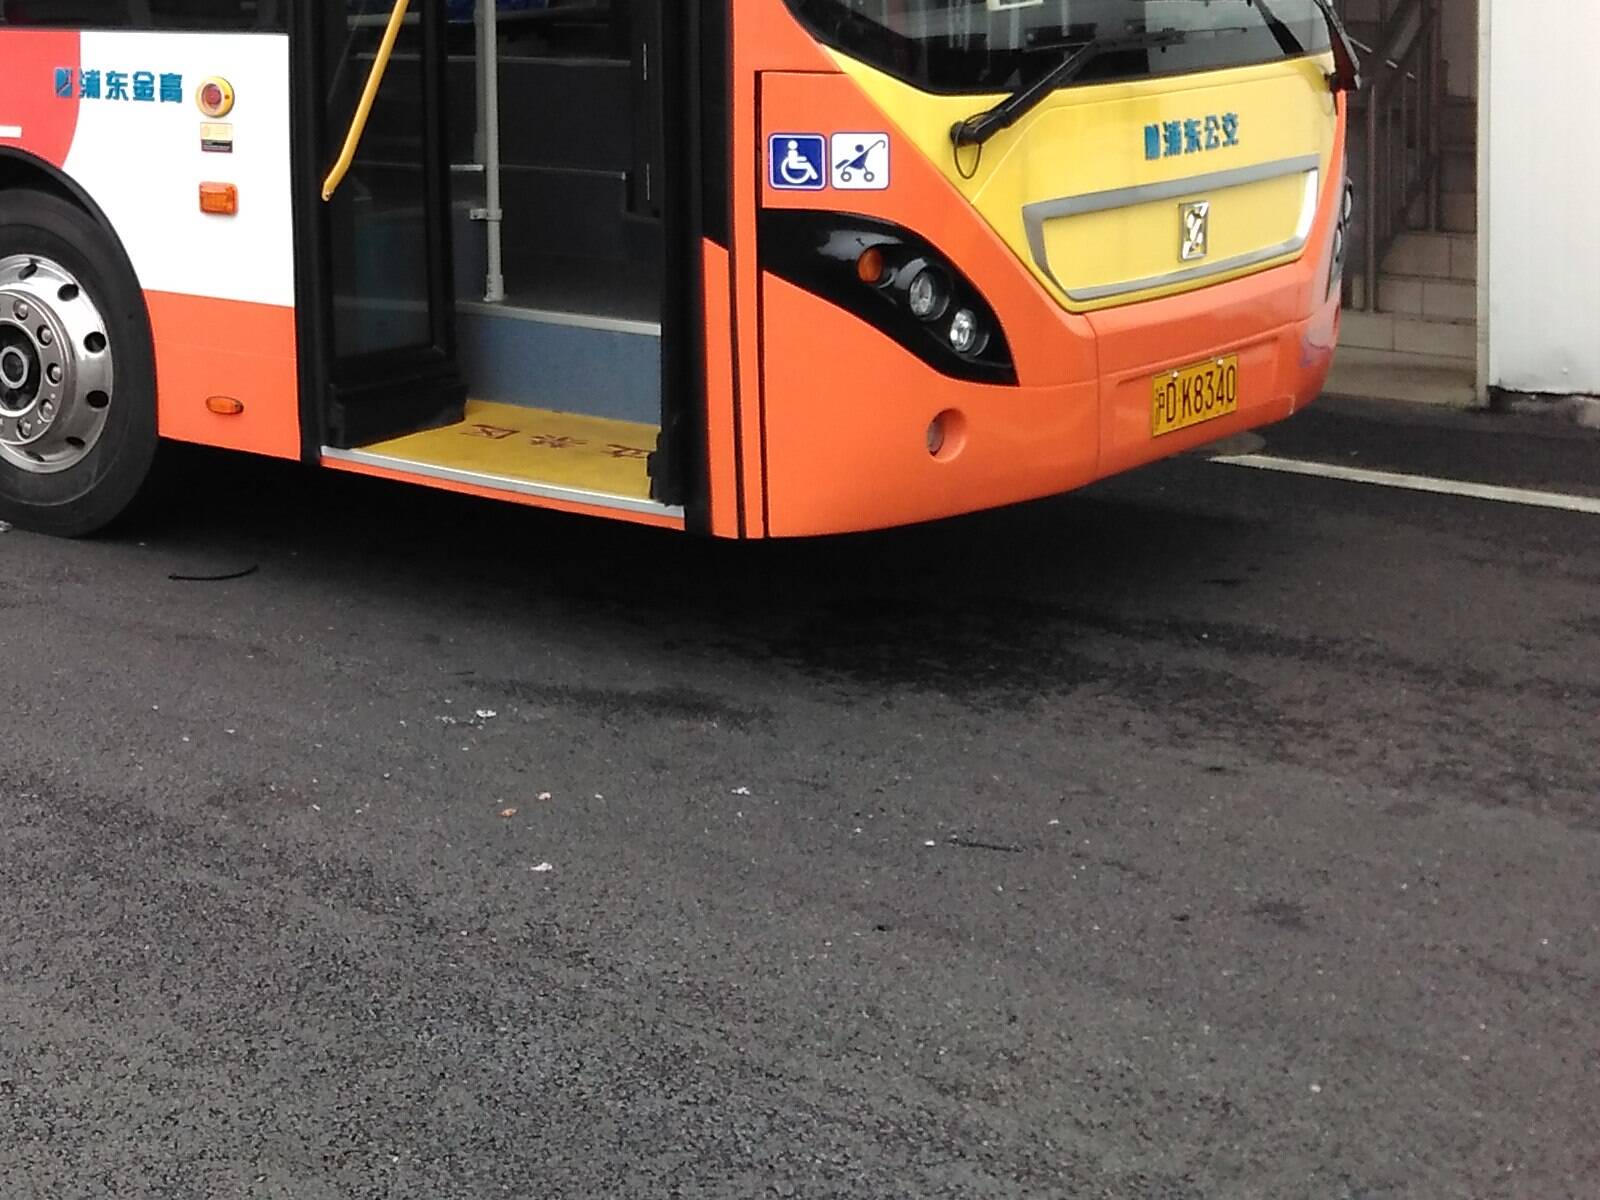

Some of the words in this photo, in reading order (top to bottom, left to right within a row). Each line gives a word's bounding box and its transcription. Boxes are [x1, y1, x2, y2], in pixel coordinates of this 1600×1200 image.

[78, 69, 183, 103] 浦东金高
[1162, 112, 1238, 157] 浦东公交
